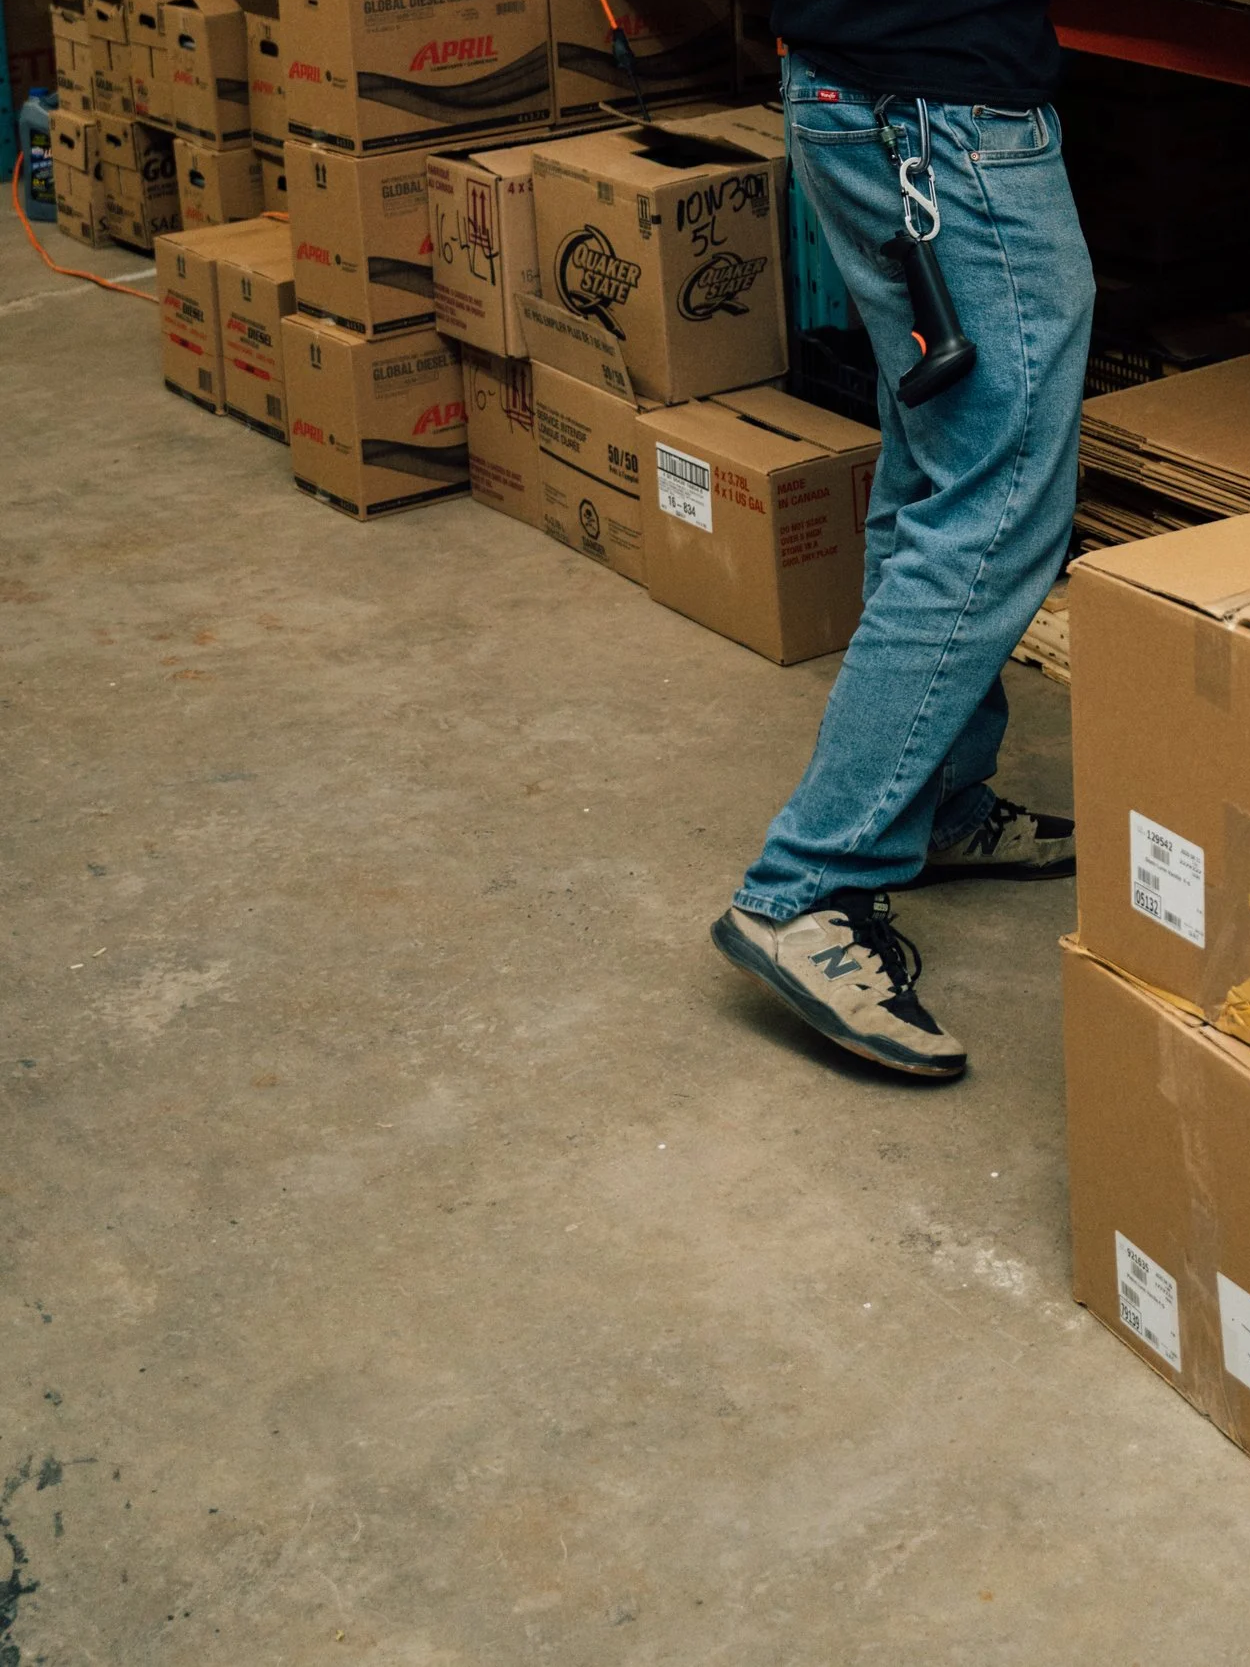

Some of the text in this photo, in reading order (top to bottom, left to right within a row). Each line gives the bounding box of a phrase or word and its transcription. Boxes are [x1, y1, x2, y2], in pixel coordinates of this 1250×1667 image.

[409, 35, 498, 72] APRIL
[288, 61, 322, 84] APRIL
[382, 180, 422, 198] GLOBAL
[297, 241, 332, 266] APRIL
[572, 242, 641, 288] QUAKER
[697, 257, 767, 289] QUAKER
[581, 270, 631, 304] STATE
[706, 274, 757, 302] STATE
[373, 354, 448, 381] GLOBAL DIESEL
[293, 418, 326, 445] APRIL
[608, 444, 639, 473] 50/50
[728, 472, 749, 492] 3.78L
[777, 478, 806, 495] MADE
[735, 492, 747, 508] US
[748, 496, 766, 515] GAL
[791, 487, 830, 507] CANADA
[1147, 830, 1173, 852] 129542
[1136, 890, 1159, 915] 05132
